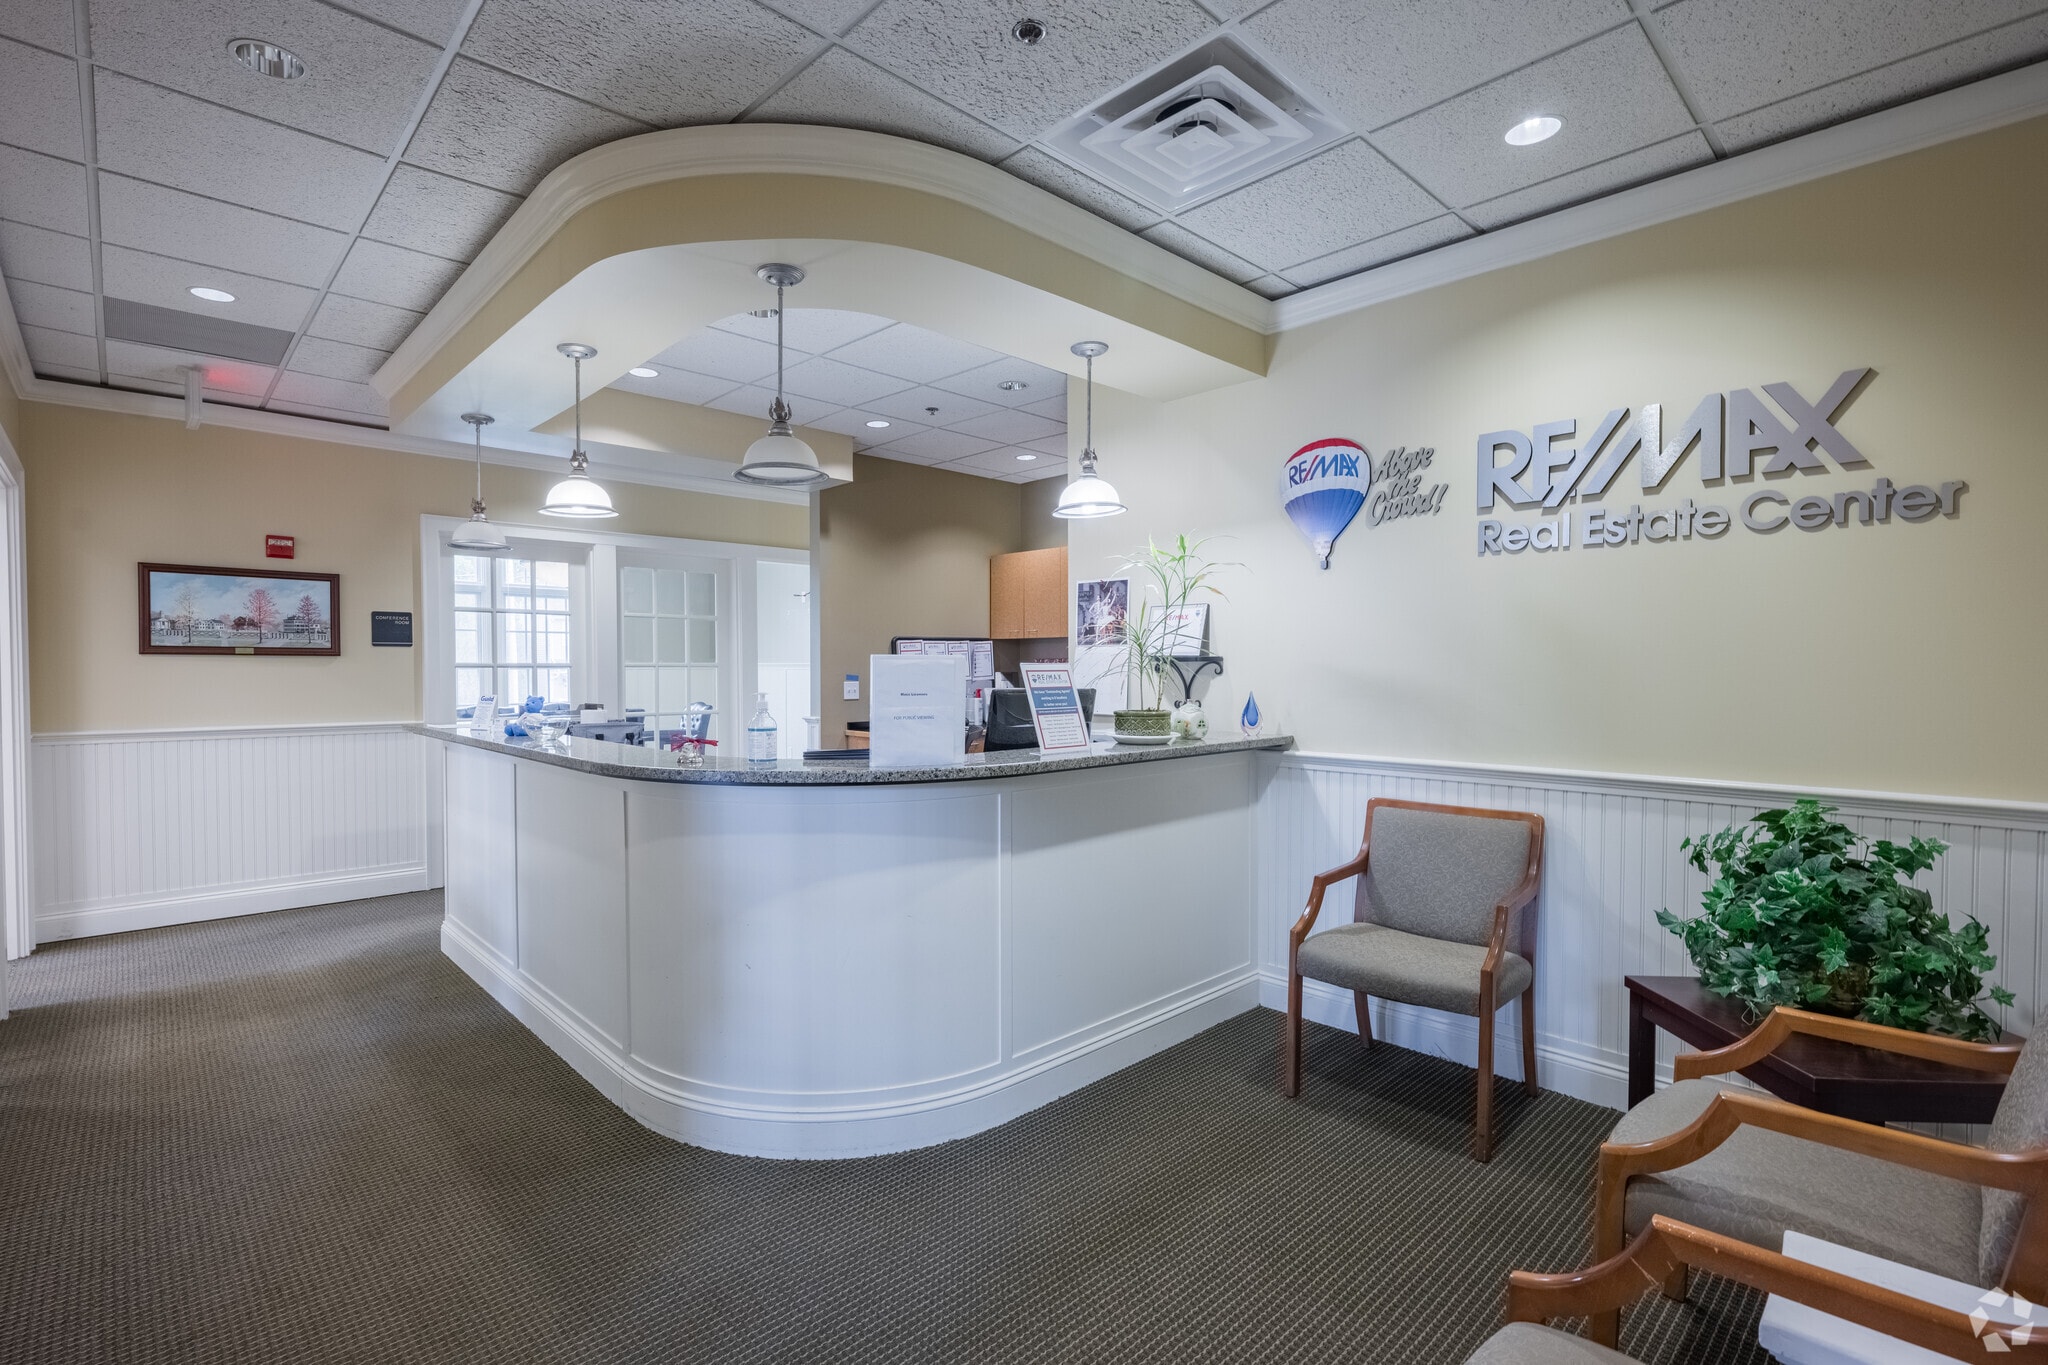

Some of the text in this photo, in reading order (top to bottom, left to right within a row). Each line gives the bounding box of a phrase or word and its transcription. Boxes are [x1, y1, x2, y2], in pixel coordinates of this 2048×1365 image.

[1477, 367, 1872, 508] RE/MAX
[1288, 453, 1360, 488] RE/MAX
[1371, 446, 1435, 484] Above
[1367, 483, 1449, 528] Crowd!
[1477, 477, 1965, 555] Real Estate Center
